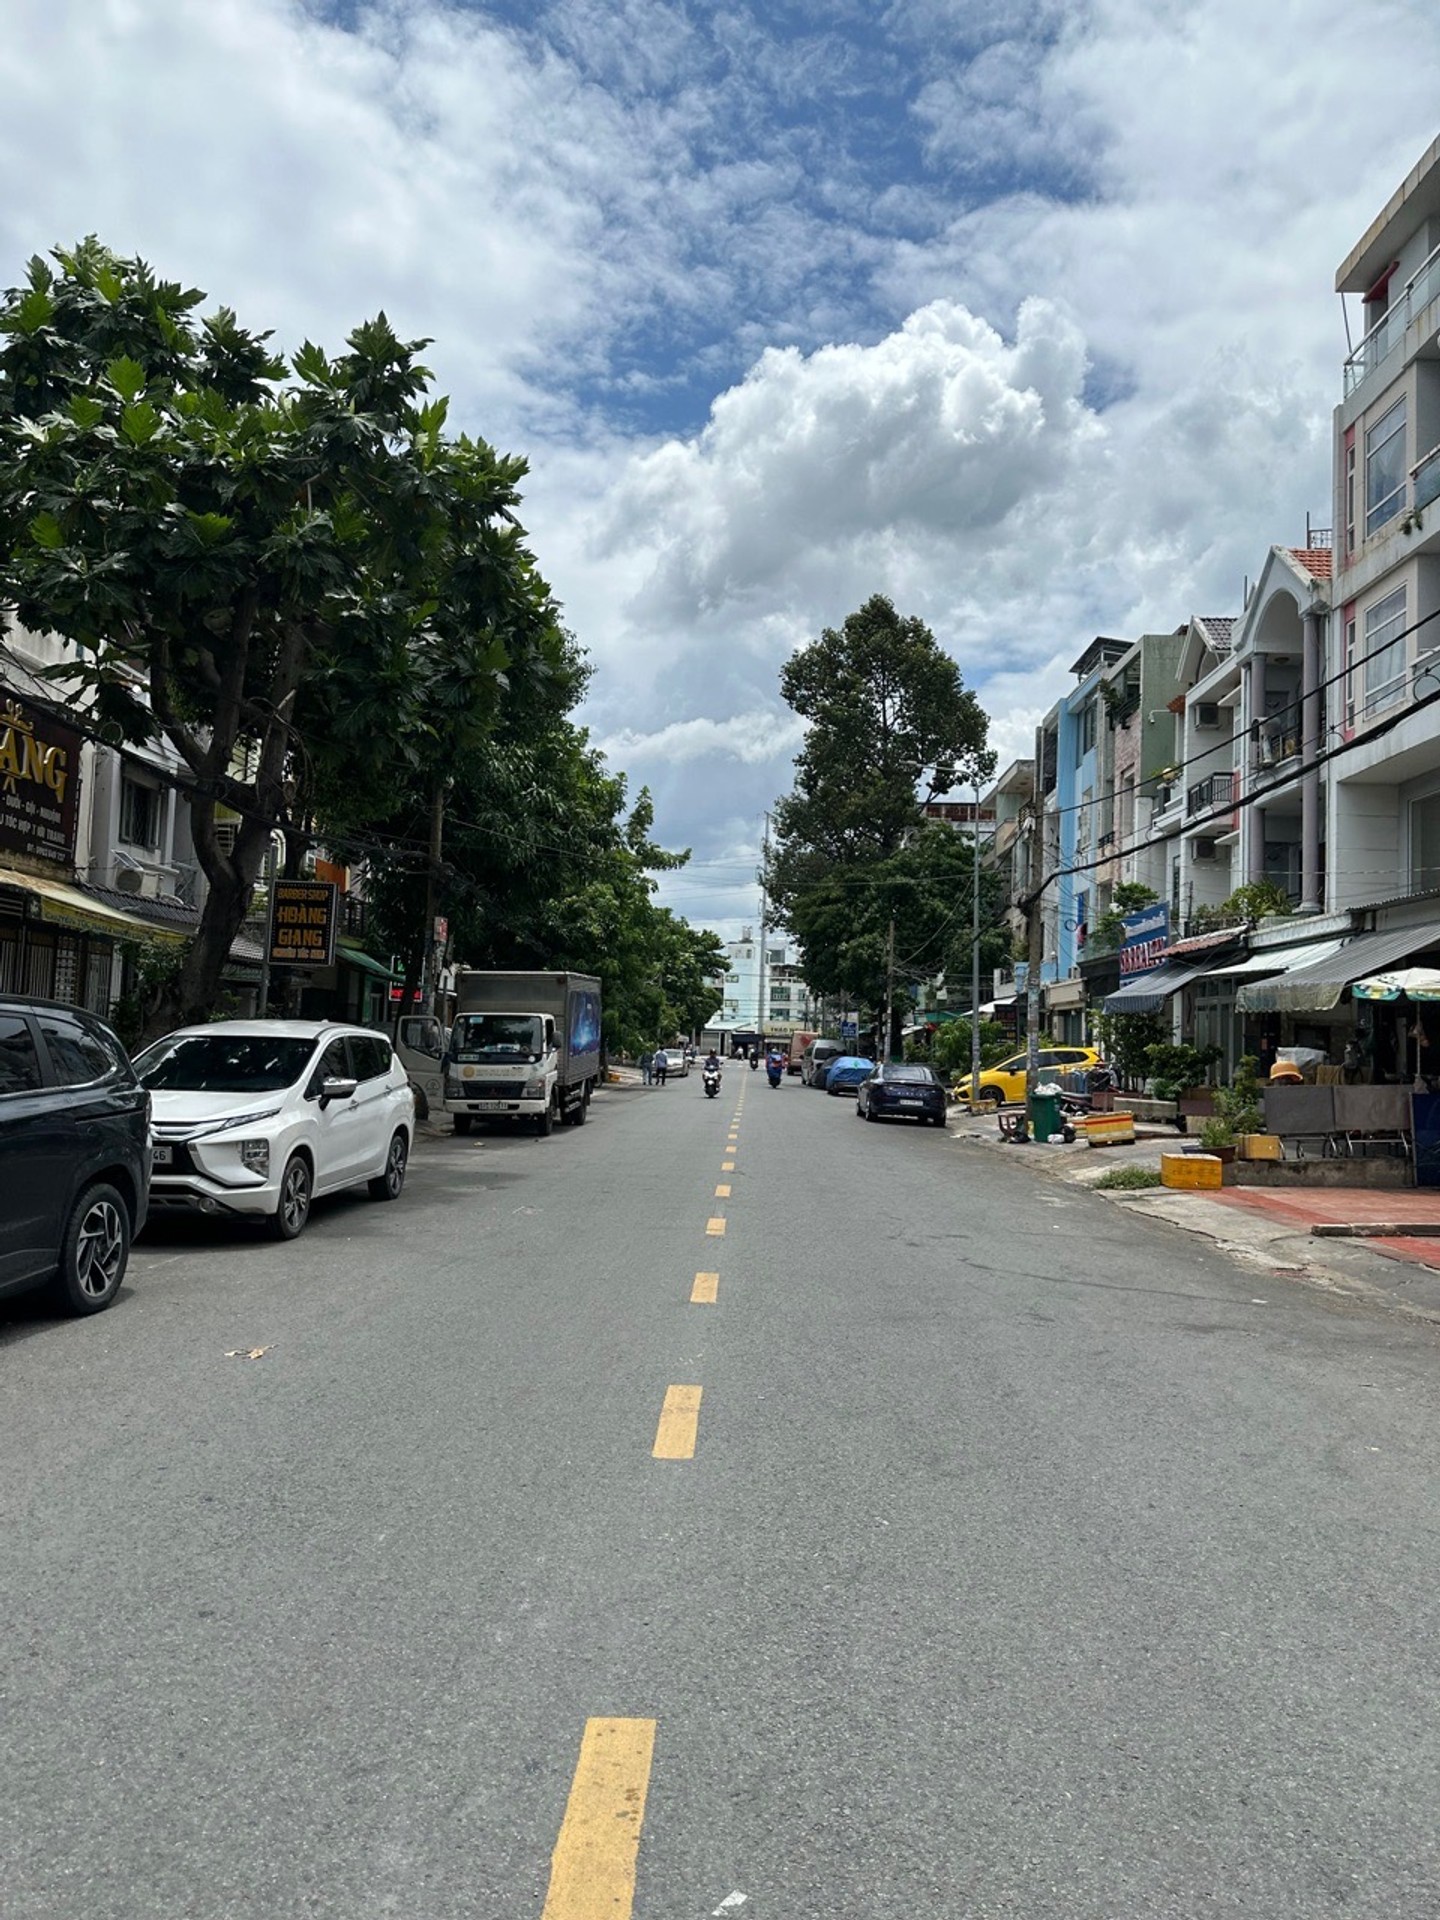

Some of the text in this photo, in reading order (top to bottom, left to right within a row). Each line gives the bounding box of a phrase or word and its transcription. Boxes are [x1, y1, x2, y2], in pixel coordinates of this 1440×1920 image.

[307, 889, 328, 901] SHOP
[277, 903, 327, 925] HOÀNG
[278, 928, 322, 946] GIANG
